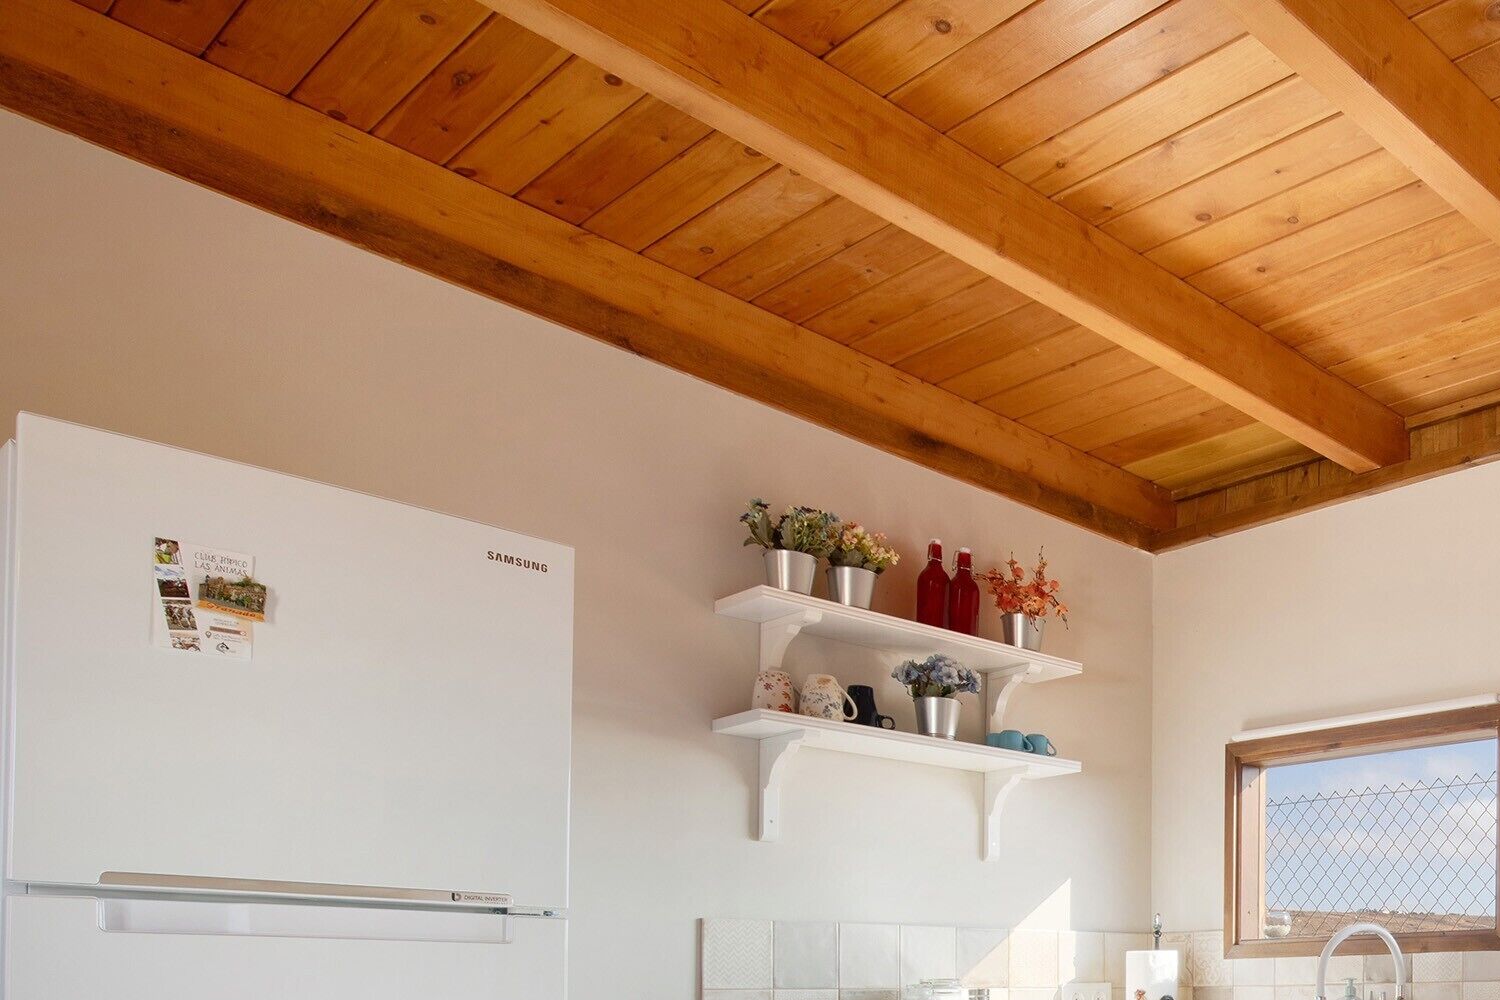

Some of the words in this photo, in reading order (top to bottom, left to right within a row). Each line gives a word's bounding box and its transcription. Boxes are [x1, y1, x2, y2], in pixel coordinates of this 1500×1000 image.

[194, 551, 216, 563] CLUB
[487, 550, 548, 573] SAMSUNG
[194, 560, 211, 571] LAS
